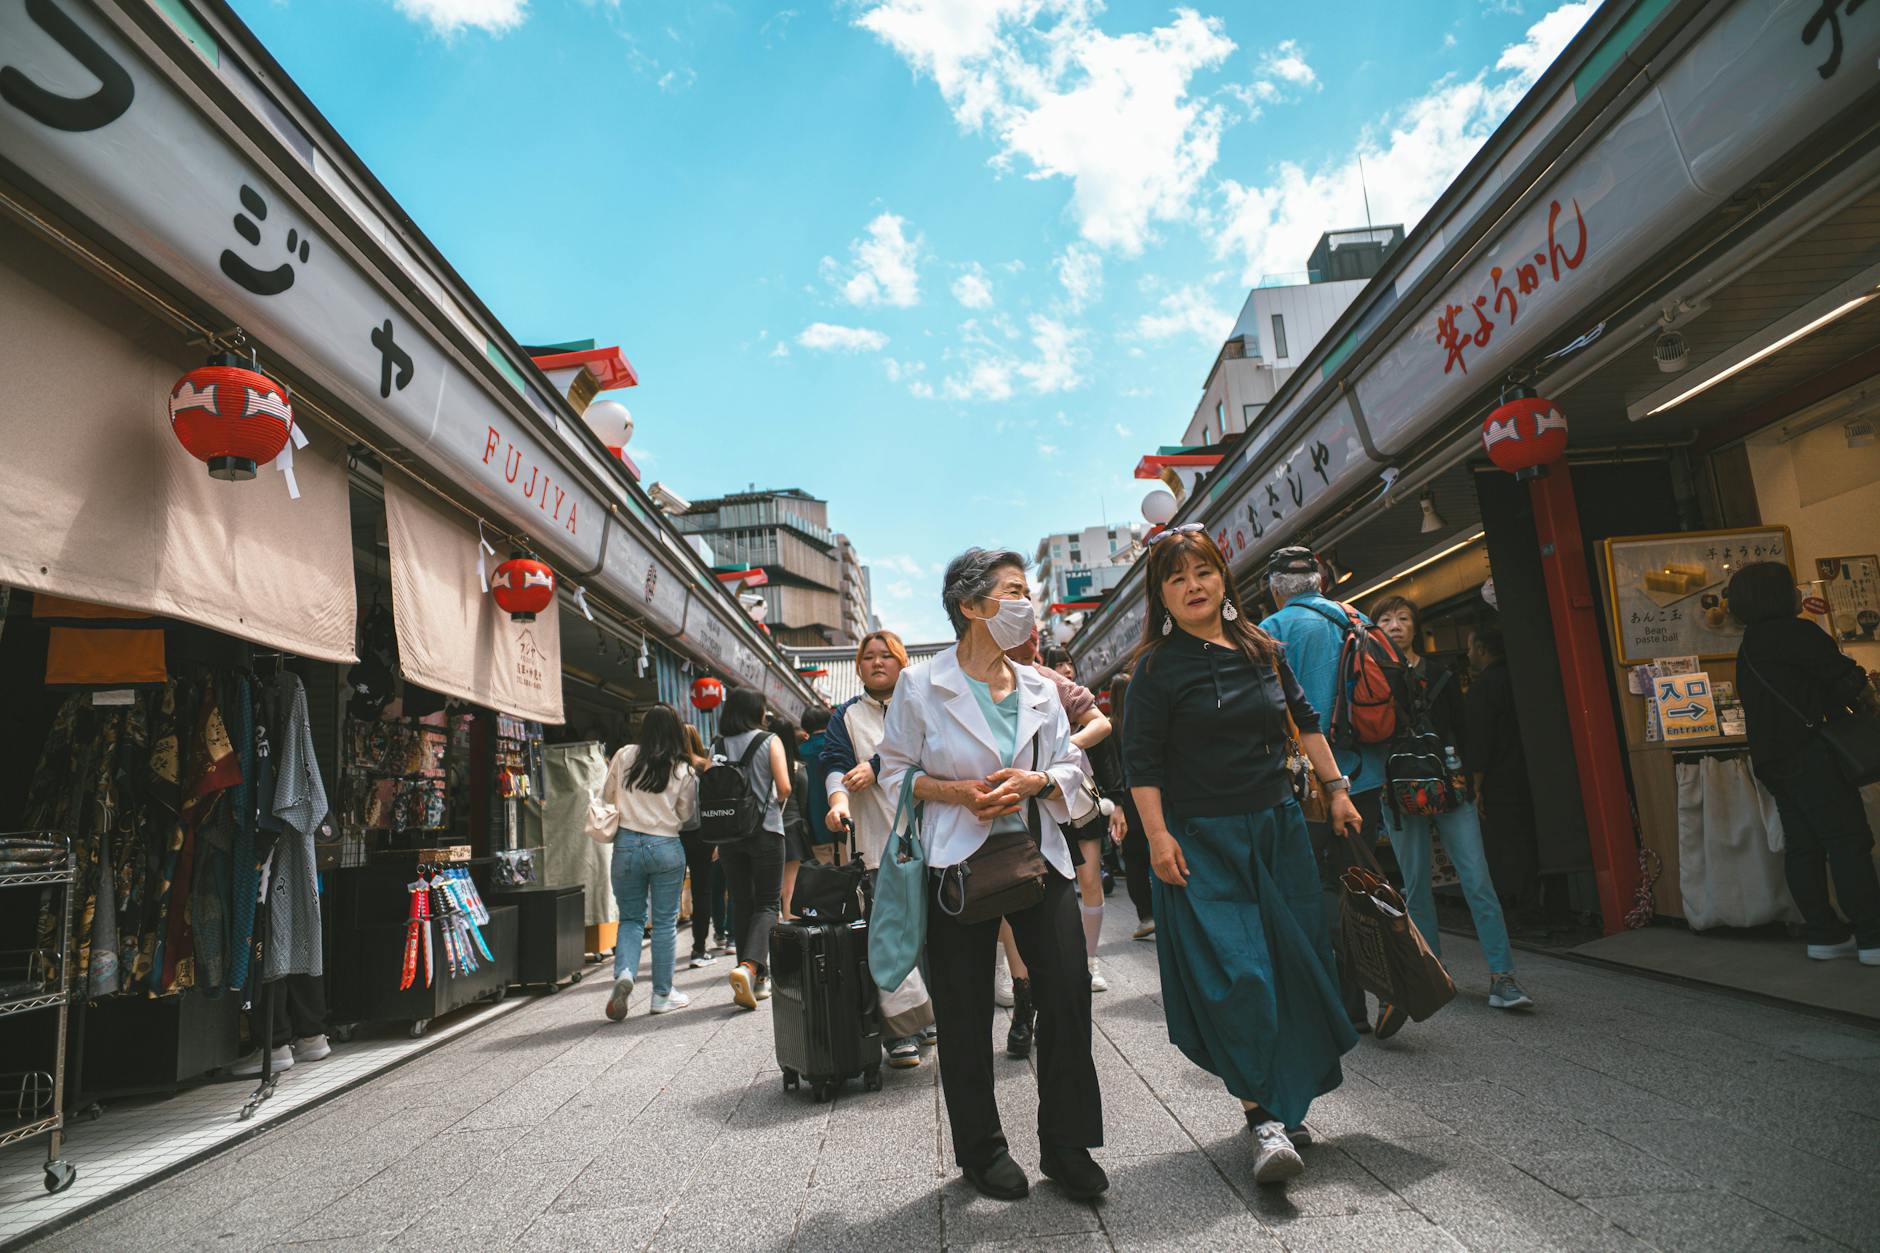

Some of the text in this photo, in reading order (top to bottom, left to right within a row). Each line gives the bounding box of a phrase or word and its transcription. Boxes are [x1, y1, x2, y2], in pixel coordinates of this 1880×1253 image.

[482, 425, 578, 535] FUJIYA
[1706, 544, 1782, 560] 芋ようかん
[1630, 609, 1682, 624] あんこ玉
[1644, 626, 1668, 635] Bean
[1634, 632, 1679, 647] paste ball
[1660, 681, 1708, 702] 入口
[1667, 725, 1717, 736] Entrance
